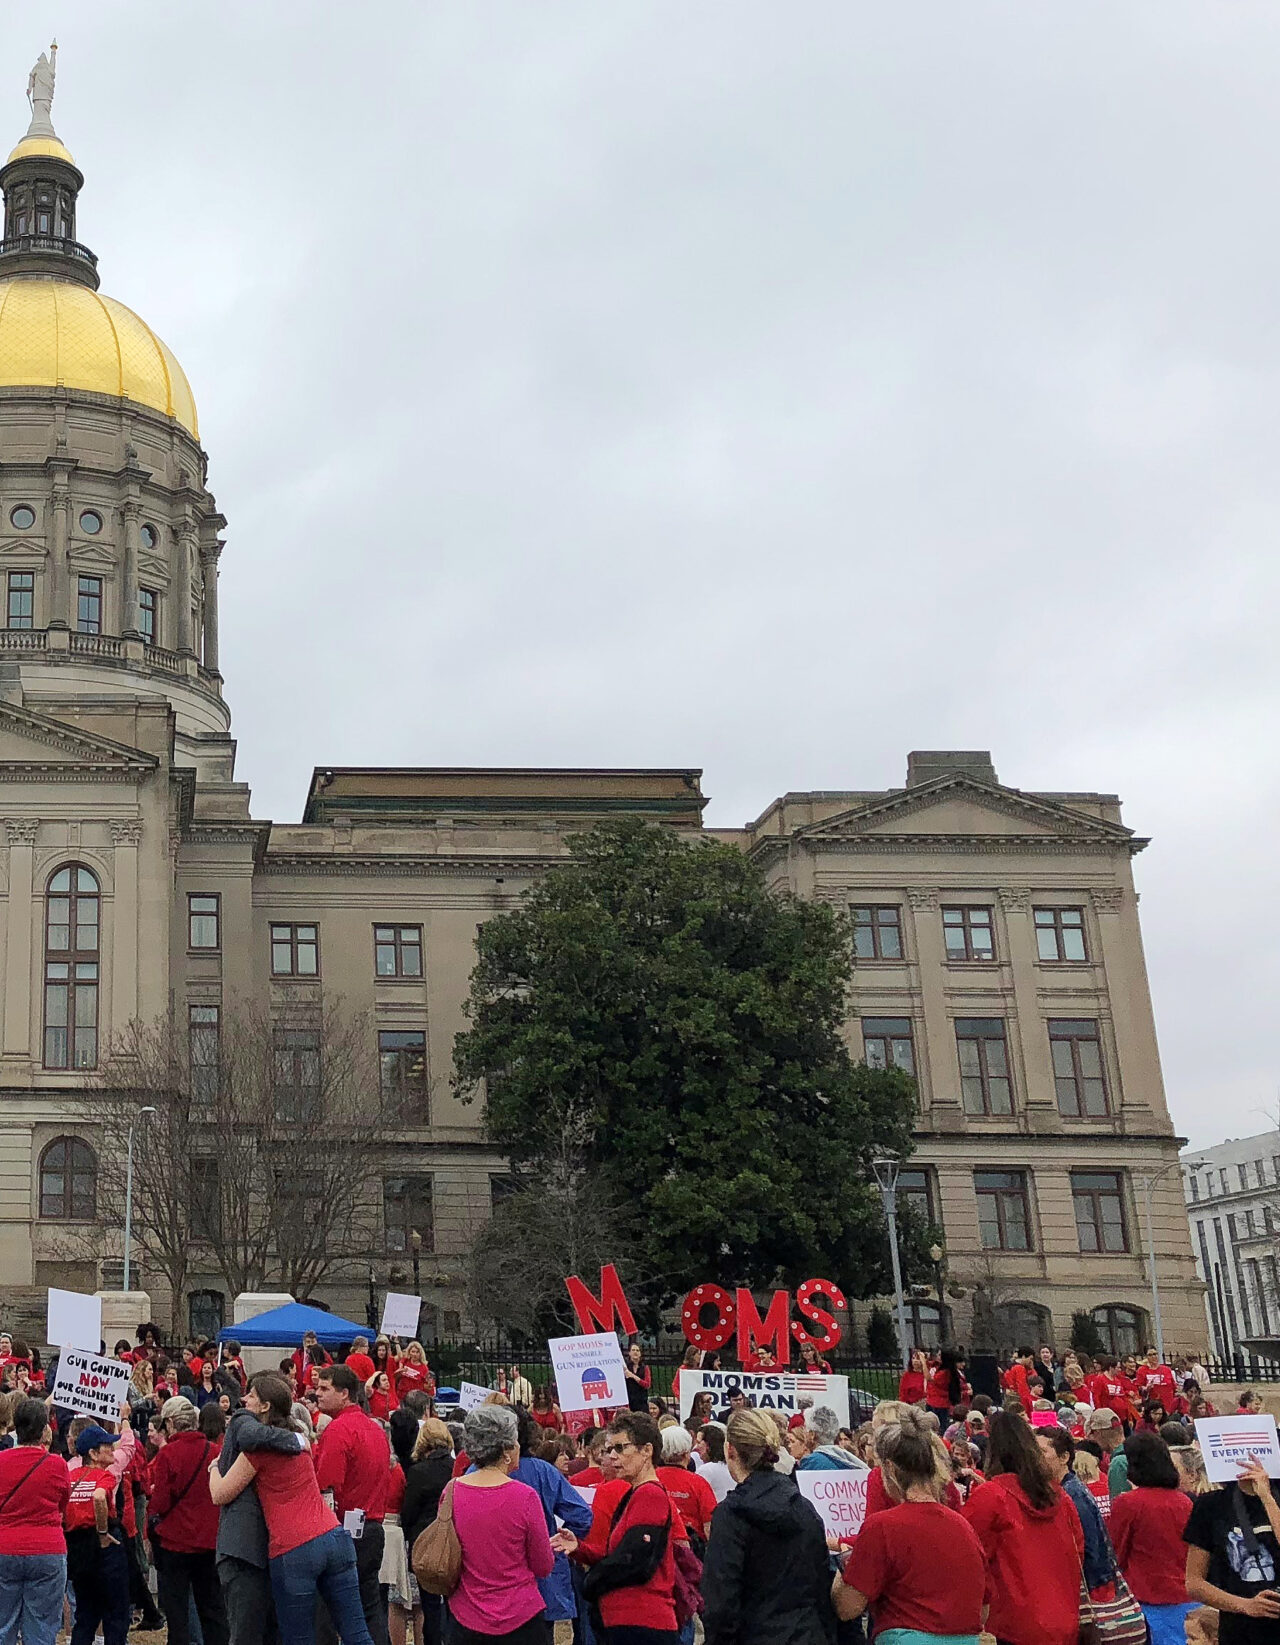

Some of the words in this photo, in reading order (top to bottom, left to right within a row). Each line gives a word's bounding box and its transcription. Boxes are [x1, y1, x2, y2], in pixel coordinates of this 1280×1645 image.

[557, 1343, 576, 1352] GOP
[577, 1340, 604, 1350] MOMS
[67, 1355, 88, 1370] GUN
[91, 1361, 130, 1380] CONTROL
[556, 1361, 575, 1370] GUN
[576, 1358, 621, 1368] REGULATIONS
[57, 1381, 74, 1392] OUR
[79, 1372, 110, 1389] NOW
[702, 1373, 781, 1391] MOMS
[1211, 1447, 1273, 1458] EVERYTOWN
